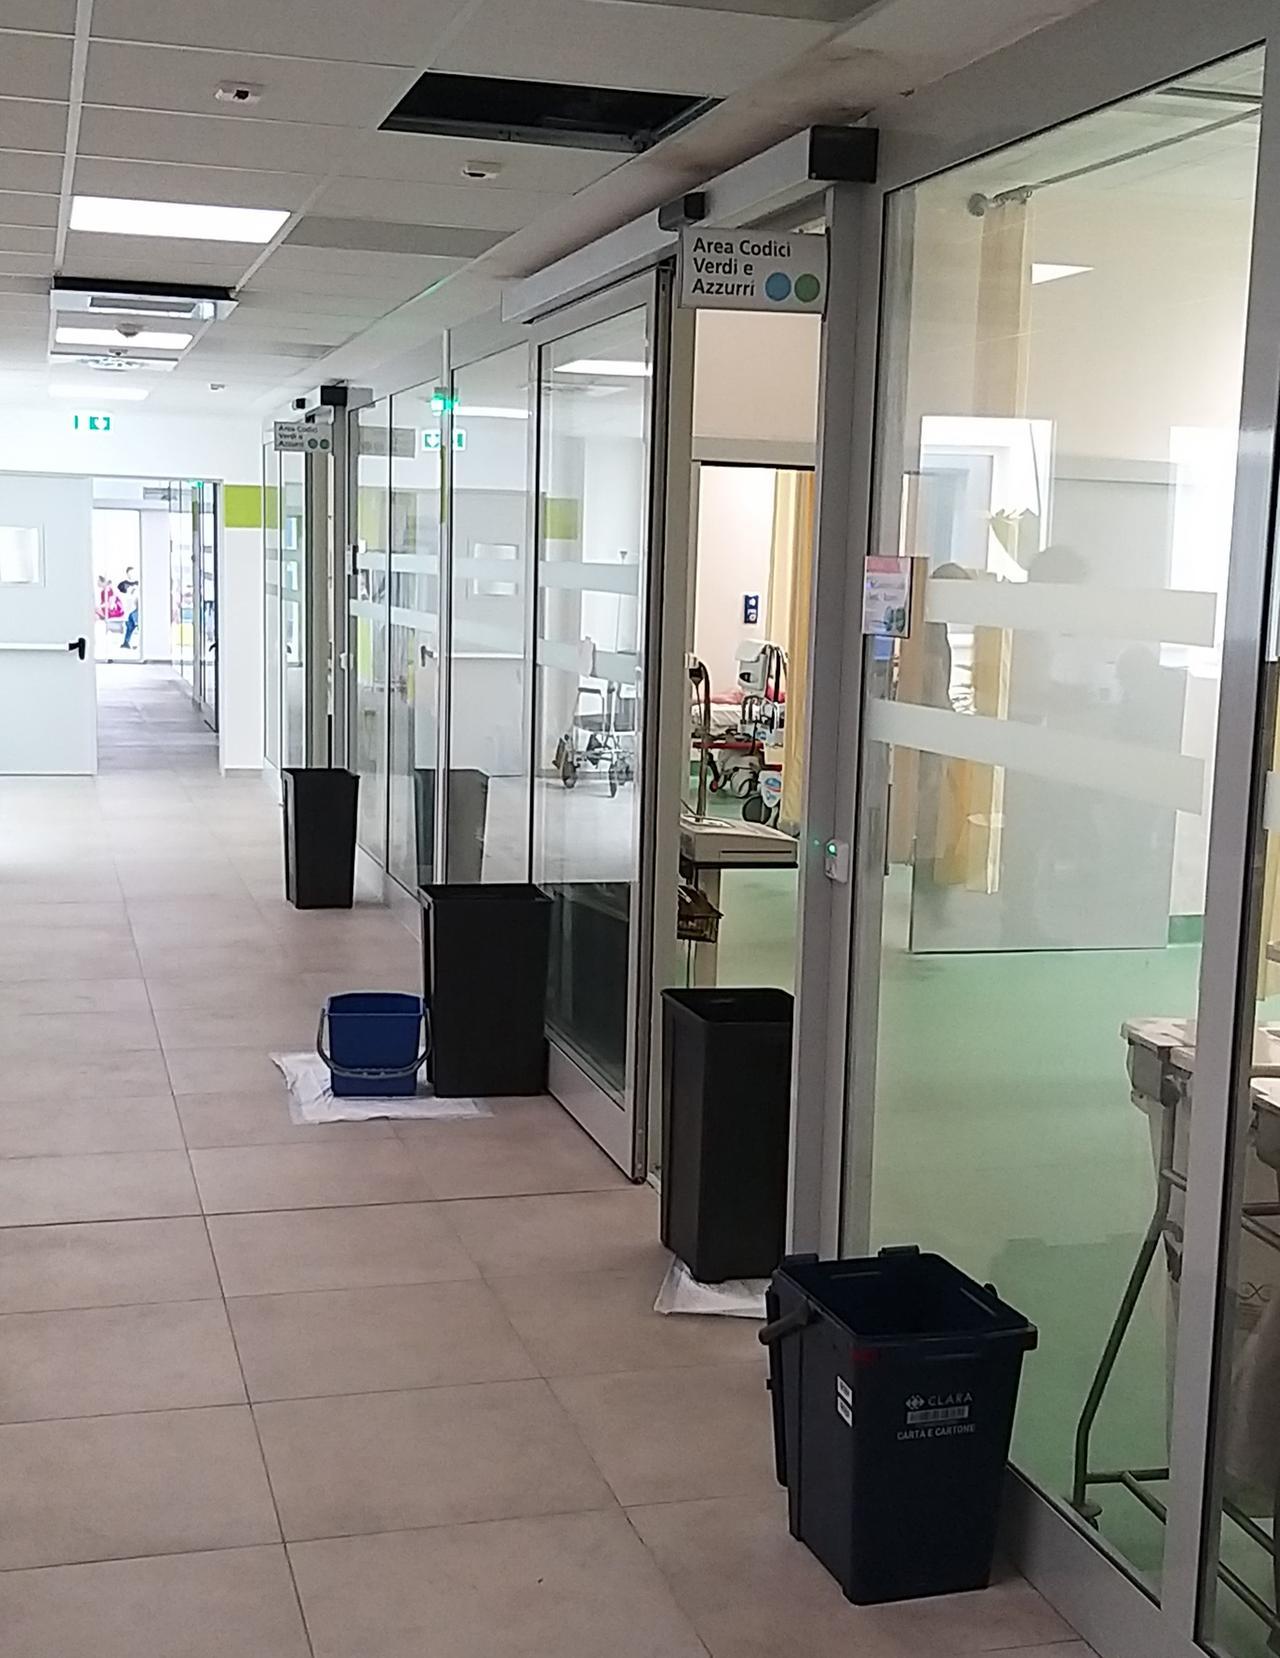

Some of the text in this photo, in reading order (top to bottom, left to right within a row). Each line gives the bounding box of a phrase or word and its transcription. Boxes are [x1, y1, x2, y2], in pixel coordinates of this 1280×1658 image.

[693, 237, 791, 257] Area Codici
[693, 257, 753, 276] Verdi e
[692, 278, 755, 297] Azzurri
[928, 1392, 973, 1406] CLARA
[897, 1424, 976, 1440] CARTA E CARTONE
